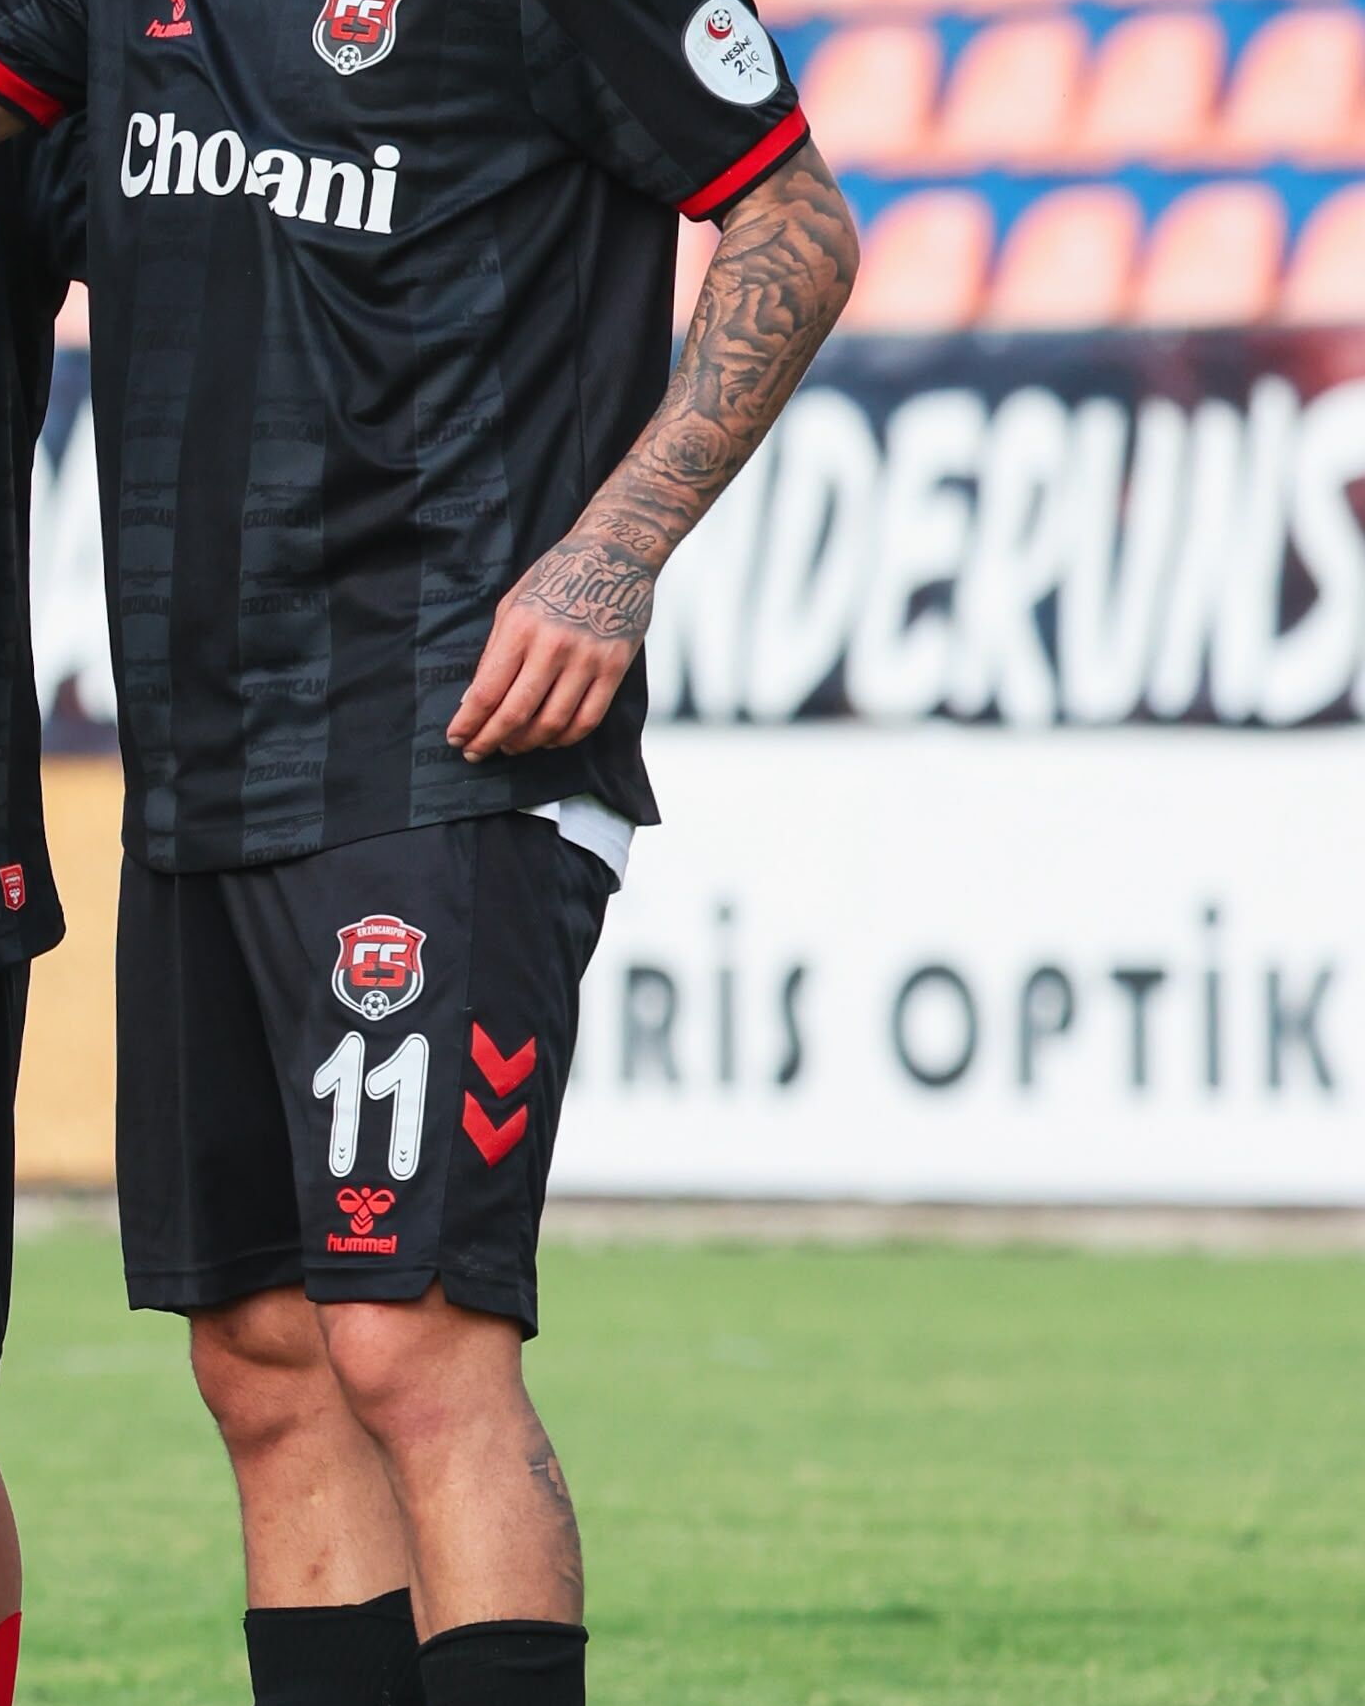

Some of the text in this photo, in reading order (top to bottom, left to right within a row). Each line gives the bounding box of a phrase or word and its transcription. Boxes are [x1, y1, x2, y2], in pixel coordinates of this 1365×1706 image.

[120, 112, 401, 235] Choani
[571, 901, 1337, 1089] RİS OPTİK
[313, 1030, 430, 1182] 11
[327, 1233, 398, 1254] hummel
